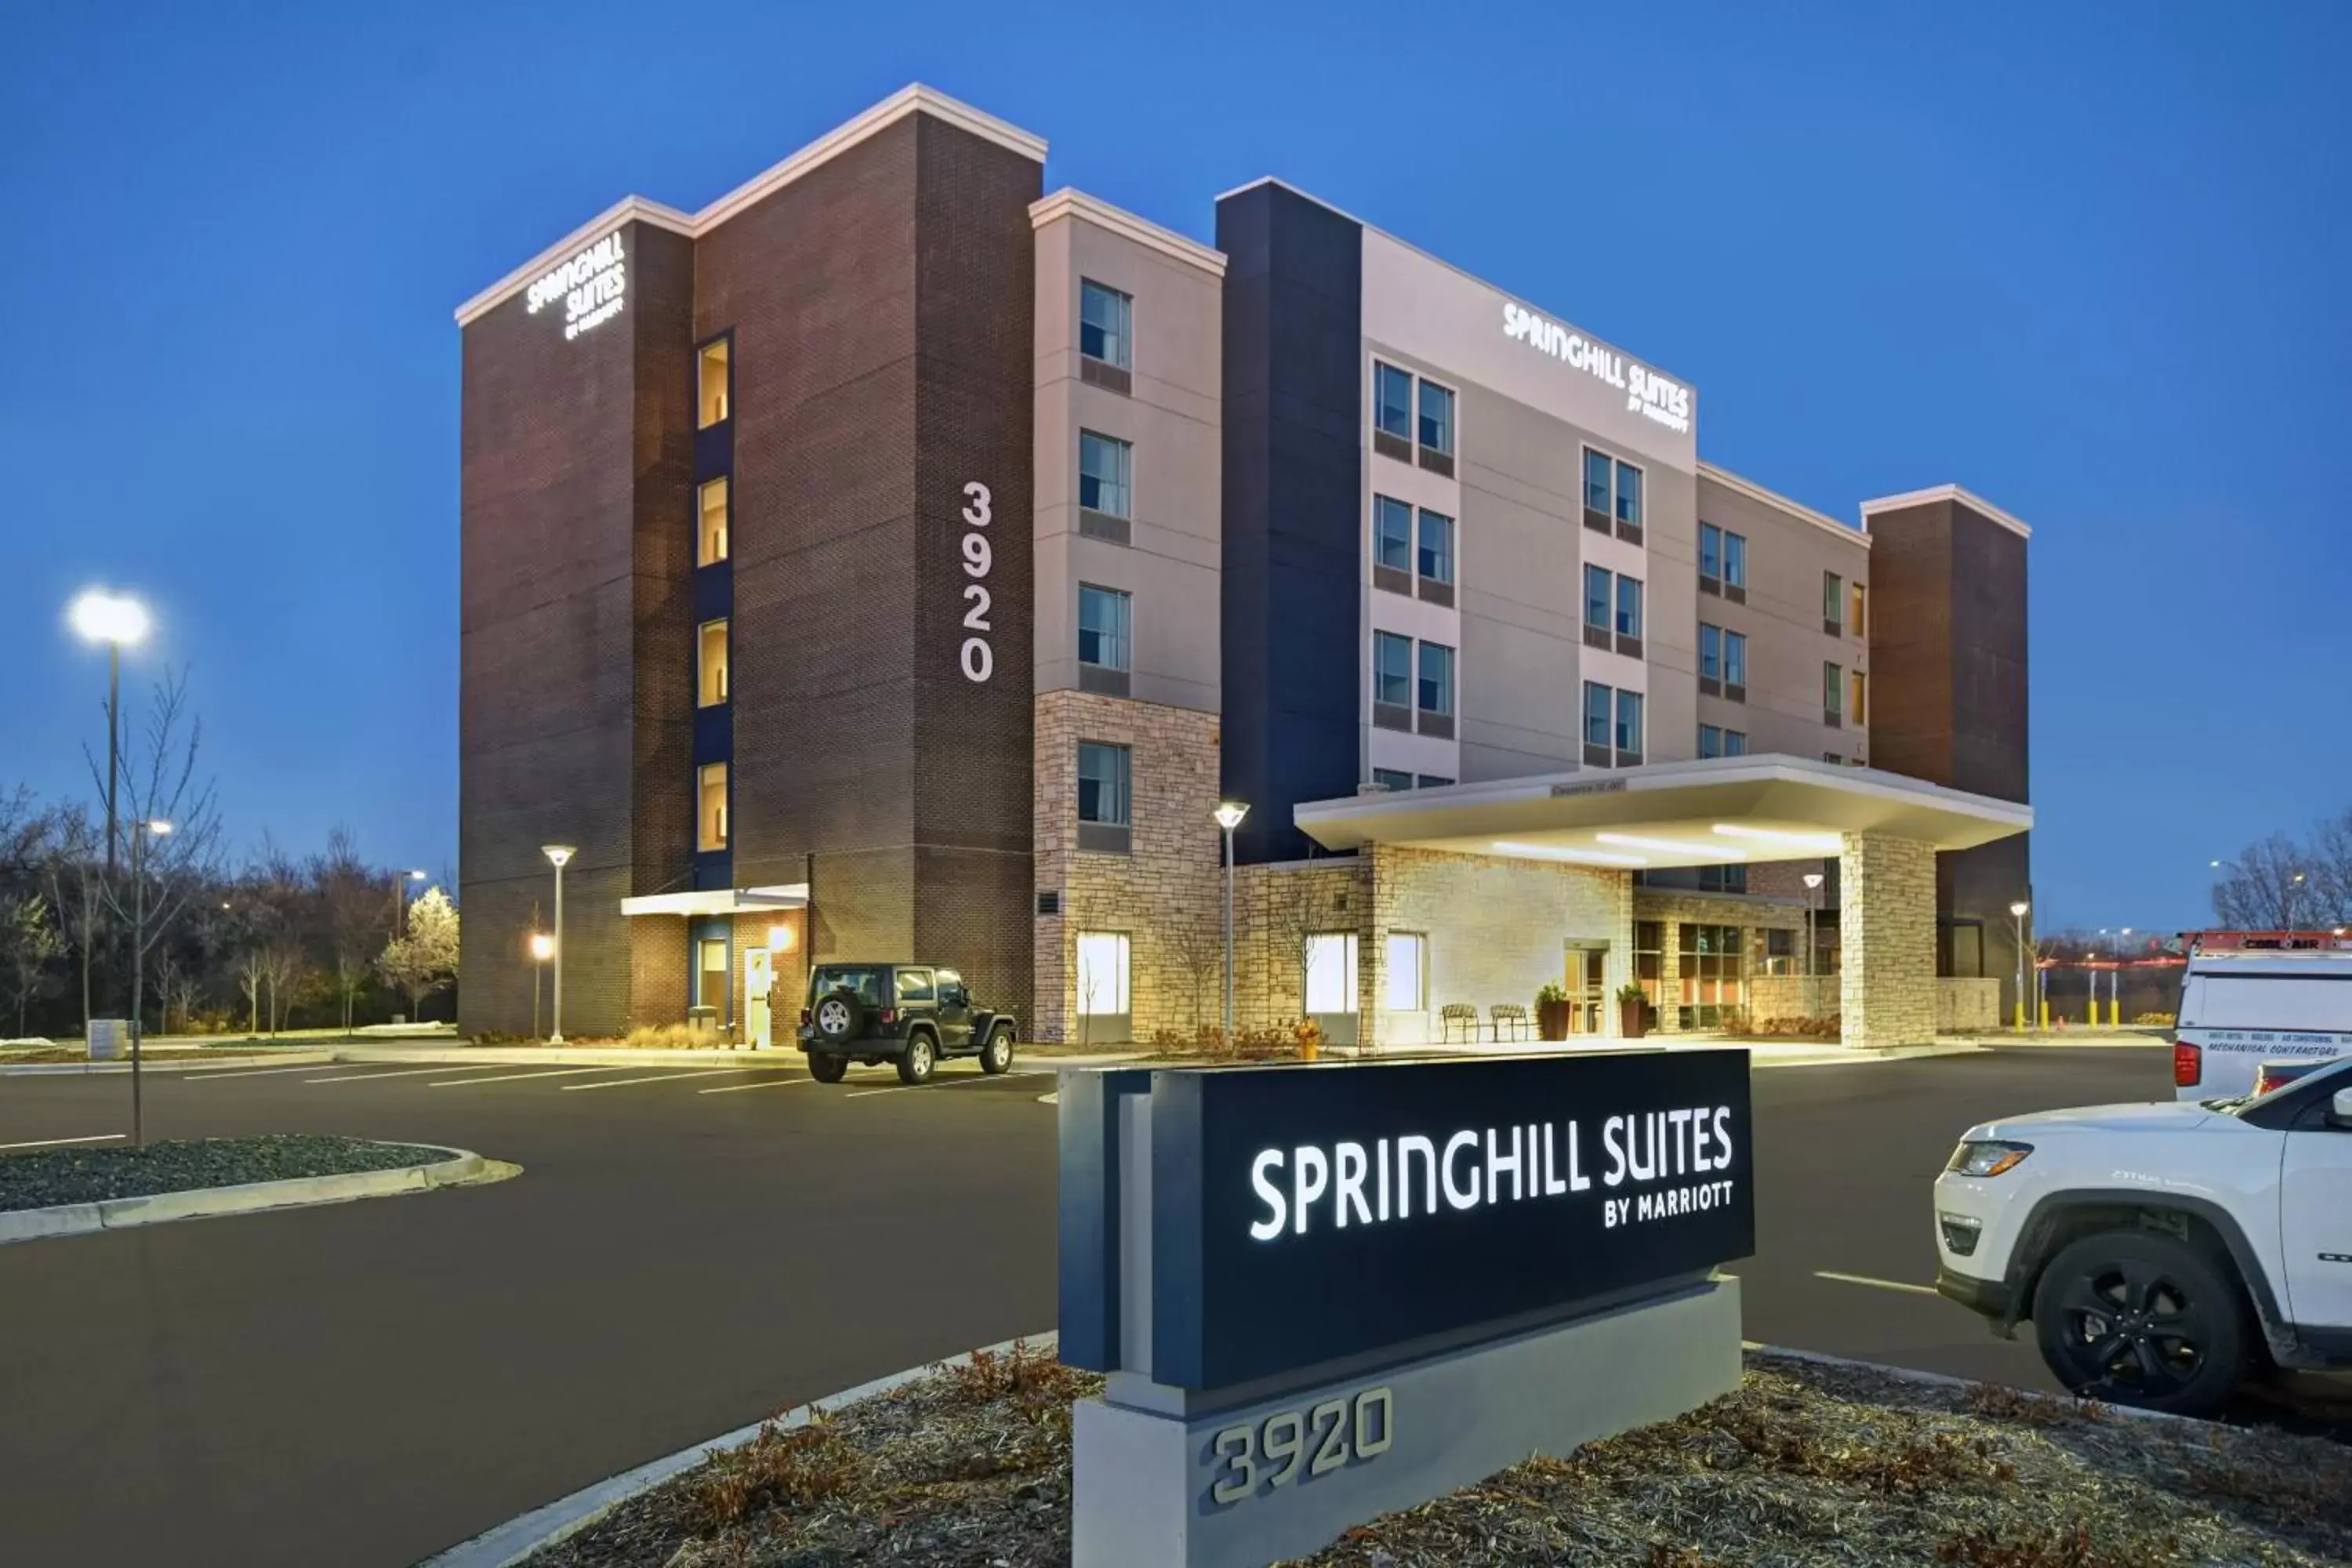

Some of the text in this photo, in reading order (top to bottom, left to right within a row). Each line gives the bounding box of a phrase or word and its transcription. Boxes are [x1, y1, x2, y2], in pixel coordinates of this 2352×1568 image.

[1503, 302, 1626, 389] SPRINGHILL
[1628, 365, 1689, 418] SUITES
[961, 481, 993, 683] 3920
[2207, 1042, 2266, 1052] MECHANICAL
[1249, 1105, 1733, 1242] SPRINGHILL SUITES
[1604, 1179, 1734, 1229] BY MARRIOTT
[1214, 1386, 1393, 1504] 3920
